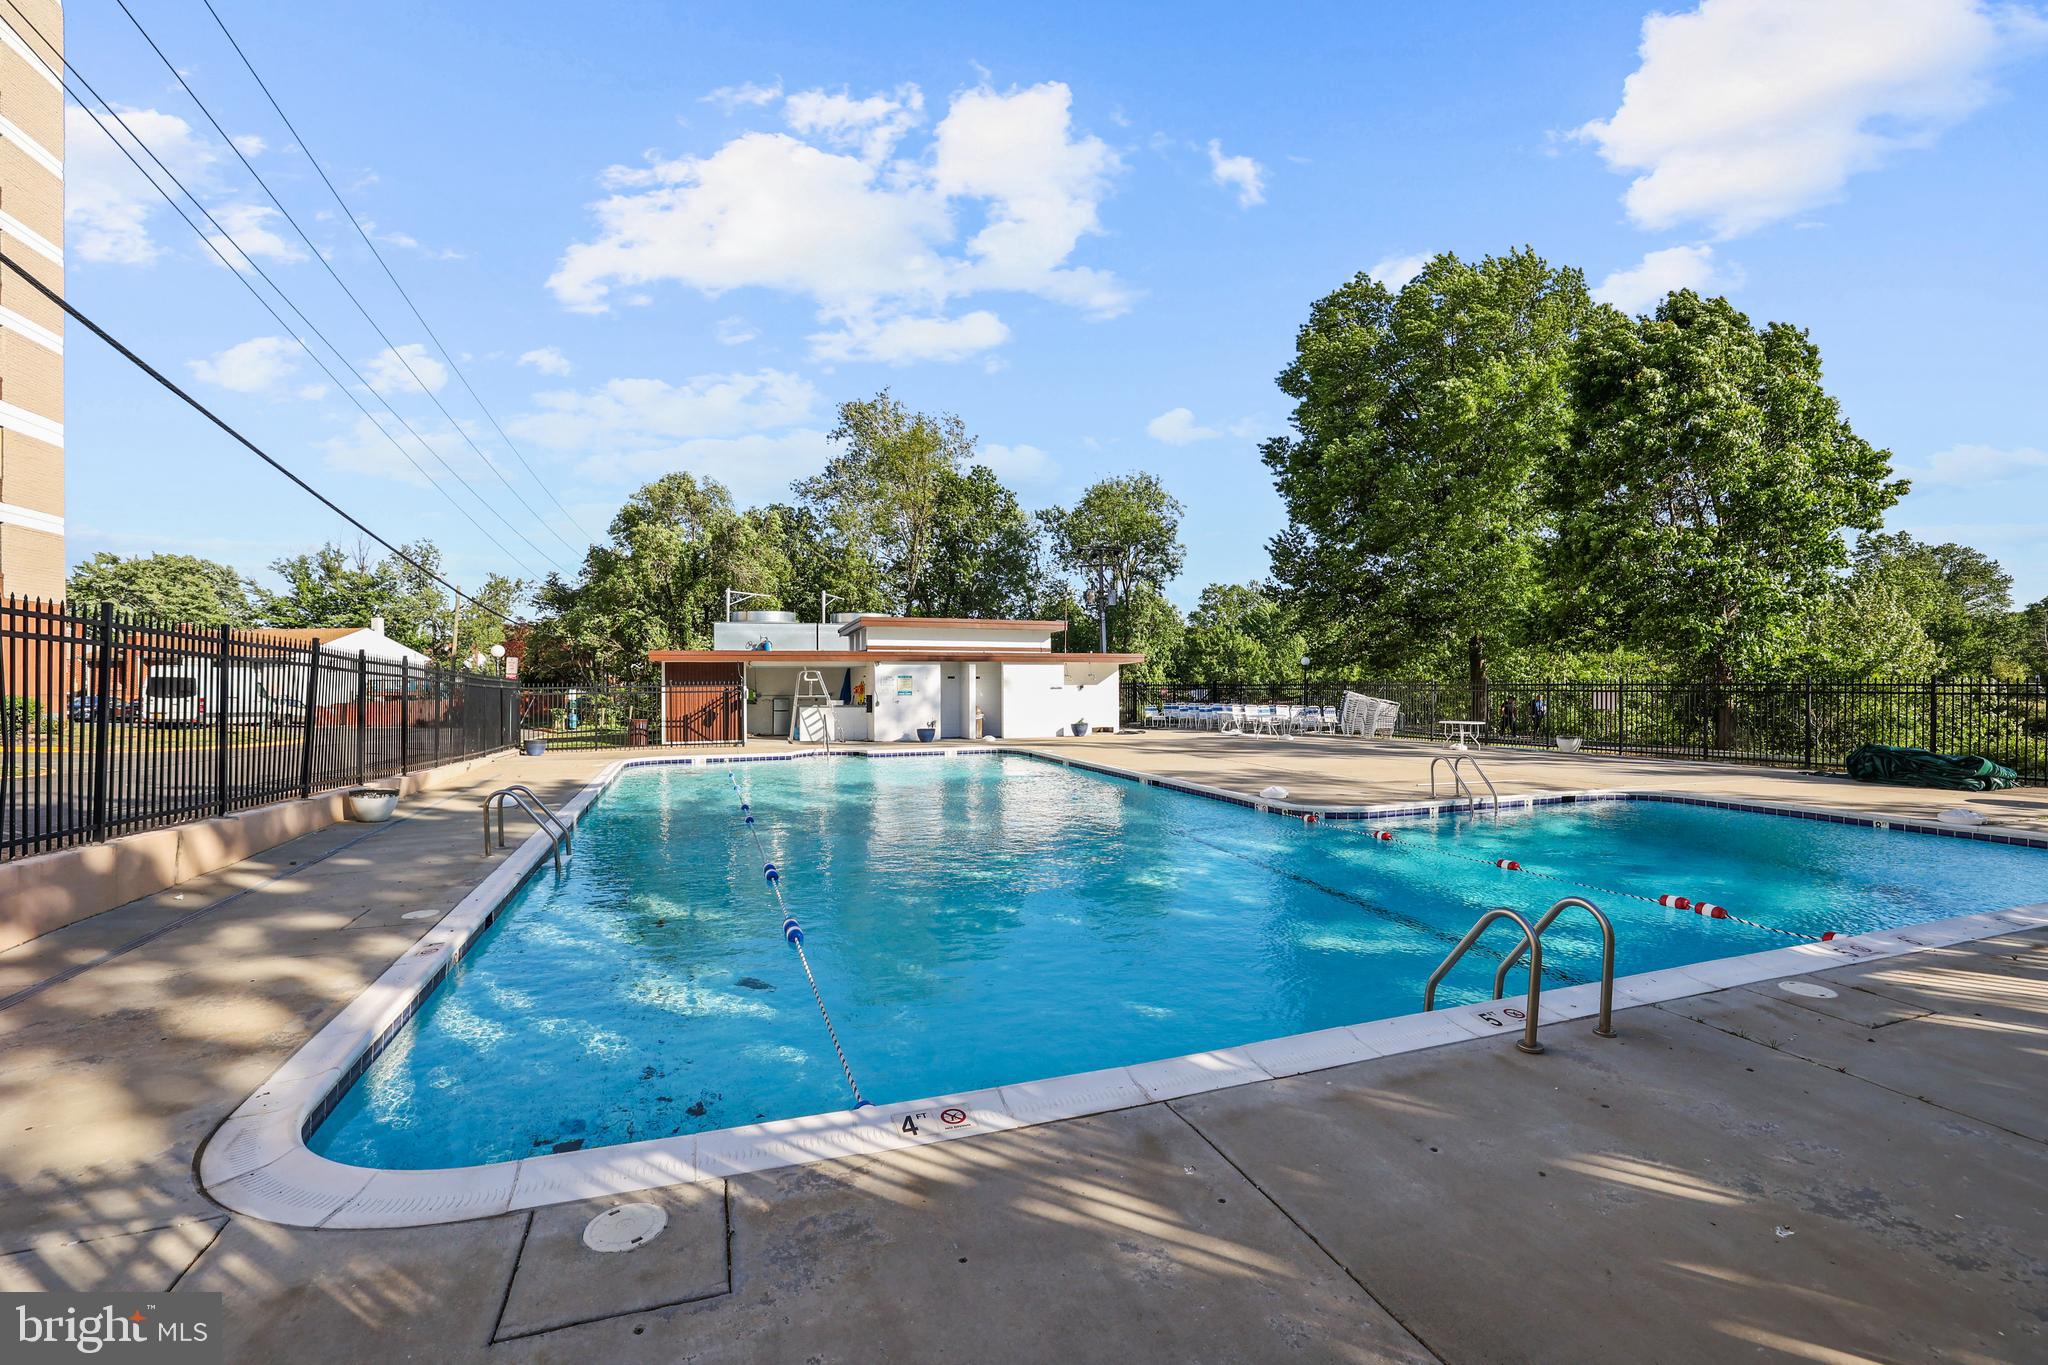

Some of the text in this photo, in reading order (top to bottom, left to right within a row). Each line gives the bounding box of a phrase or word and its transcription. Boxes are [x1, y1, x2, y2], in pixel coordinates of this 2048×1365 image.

[1478, 1012, 1503, 1026] 5
[902, 1112, 927, 1136] 4 FT
